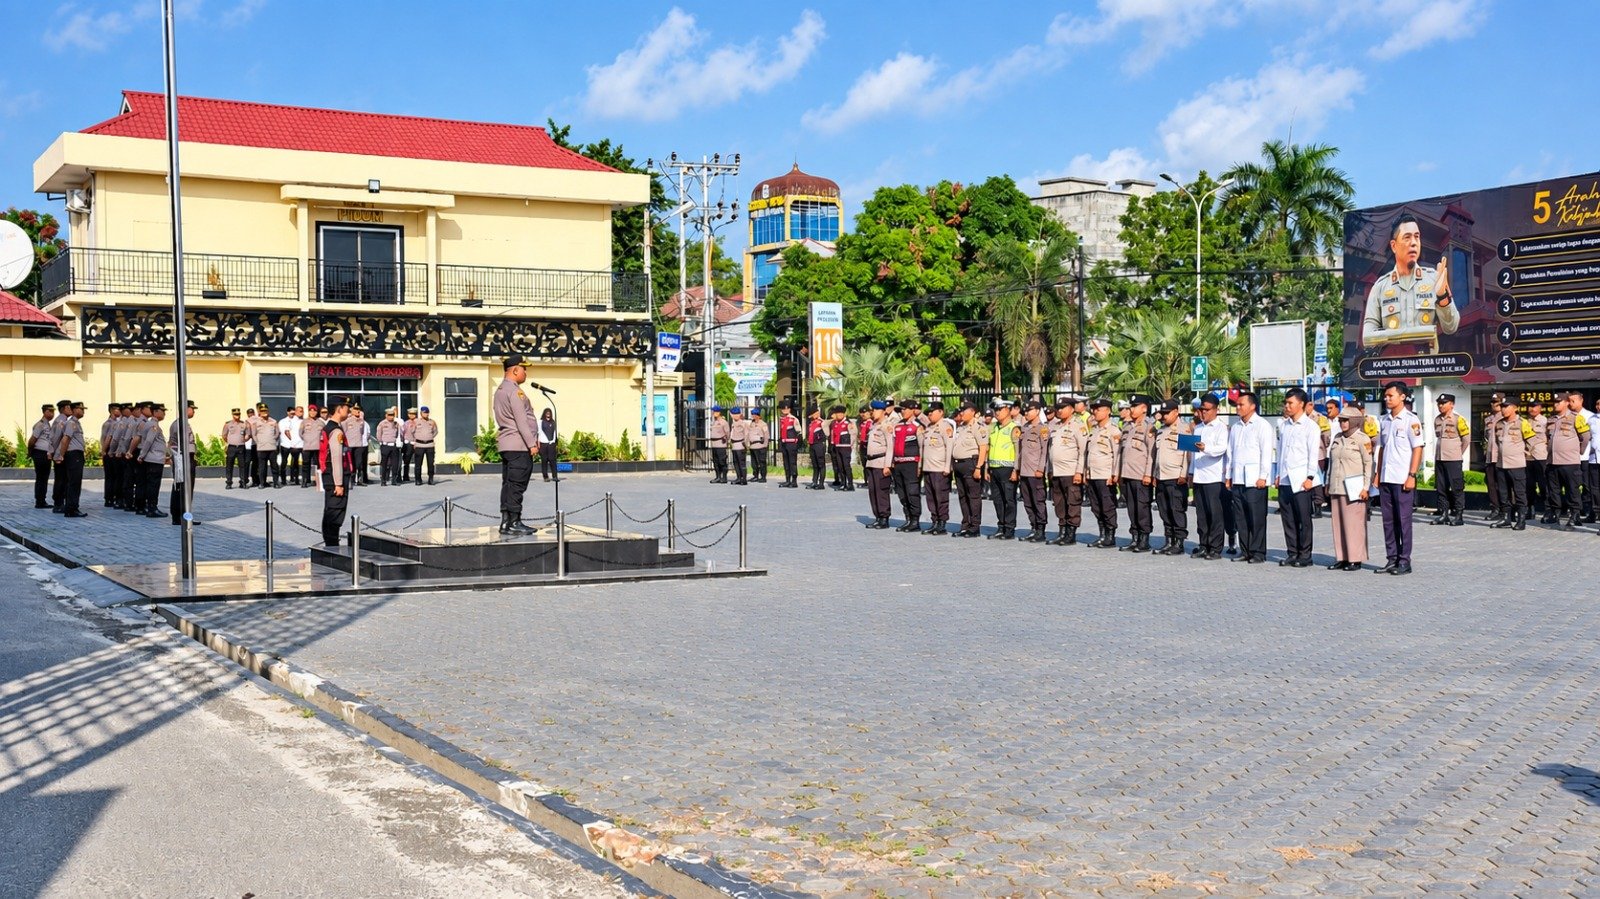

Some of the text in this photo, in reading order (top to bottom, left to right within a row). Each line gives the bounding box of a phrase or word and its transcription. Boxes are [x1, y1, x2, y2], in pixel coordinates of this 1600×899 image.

[1533, 190, 1551, 224] 5
[1503, 244, 1510, 257] 1
[1502, 272, 1510, 285] 2
[1502, 299, 1510, 312] 3
[1502, 327, 1510, 340] 4
[815, 332, 841, 362] 110
[1502, 355, 1510, 367] 5
